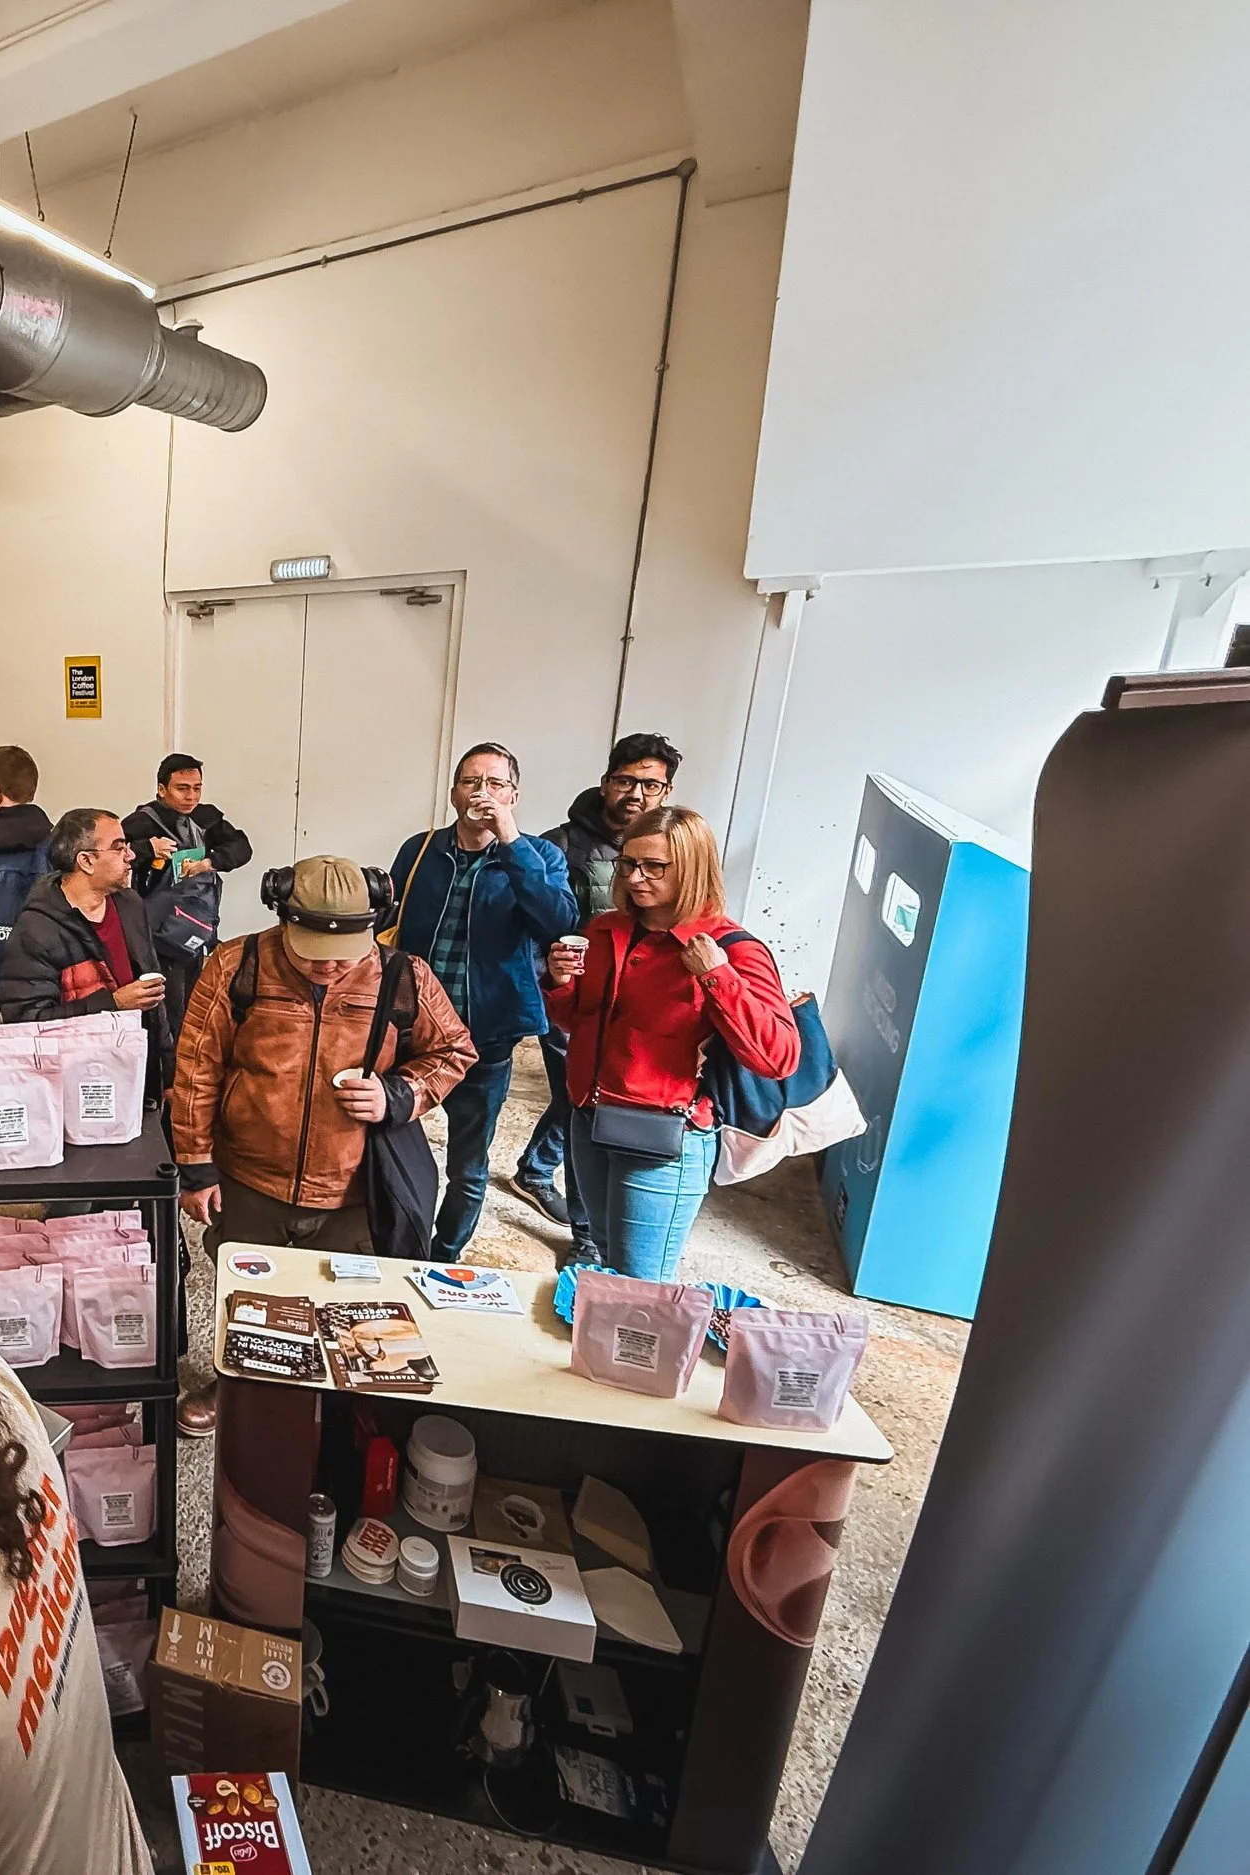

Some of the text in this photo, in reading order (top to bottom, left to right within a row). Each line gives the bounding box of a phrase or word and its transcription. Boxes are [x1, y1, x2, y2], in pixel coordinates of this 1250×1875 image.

[437, 1288, 502, 1300] nice one
[339, 1307, 399, 1316] PERFECTION
[237, 1340, 303, 1359] PRECISION IN
[356, 1521, 379, 1550] BEAN
[371, 1527, 394, 1559] JOLLY
[262, 1647, 293, 1663] PLEASE
[204, 1820, 280, 1851] Biscoff
[233, 1846, 253, 1858] Lotus
